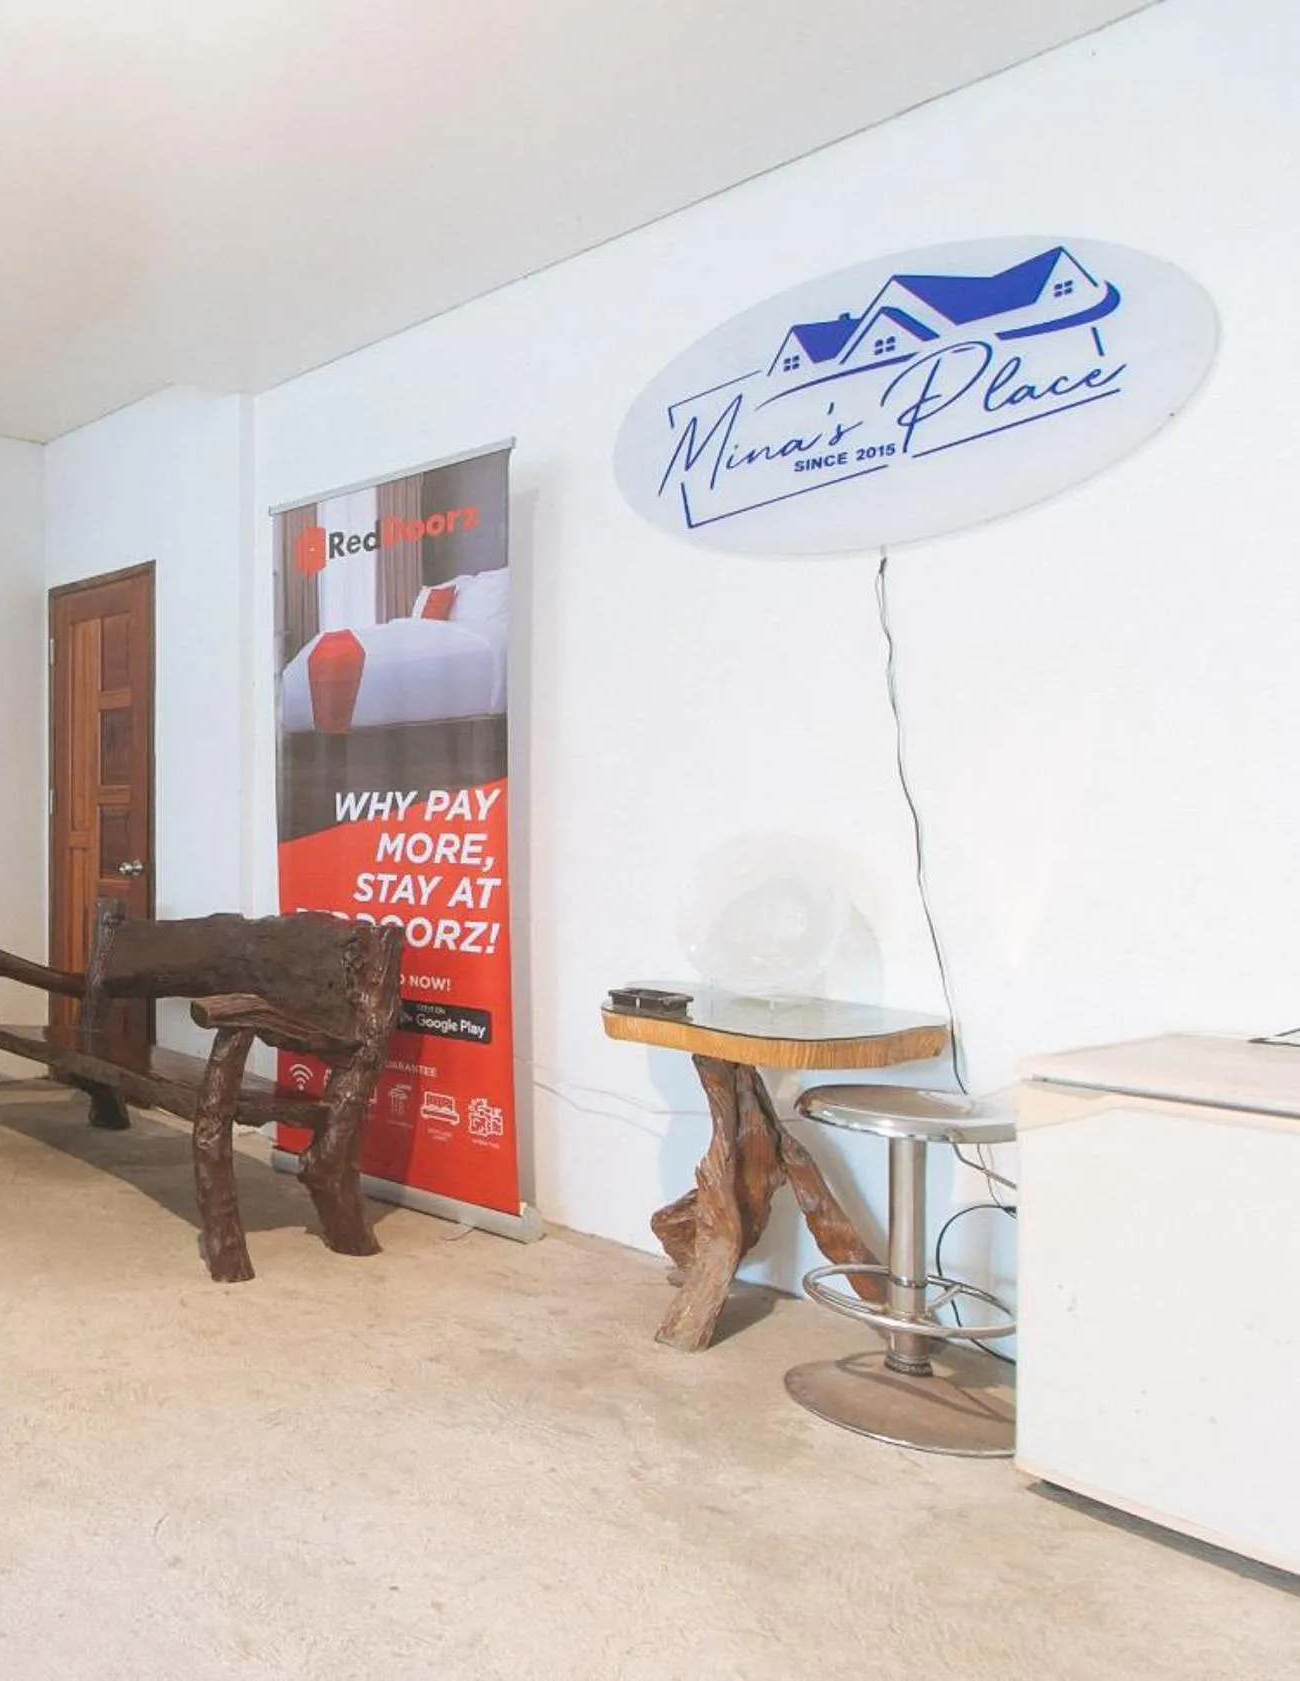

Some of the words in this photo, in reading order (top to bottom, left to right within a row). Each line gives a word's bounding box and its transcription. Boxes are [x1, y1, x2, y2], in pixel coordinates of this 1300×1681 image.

[658, 392, 864, 496] Mina's
[879, 340, 1127, 453] Place
[794, 451, 848, 472] SINCE
[856, 443, 896, 461] 2015
[328, 506, 479, 560] RedDoorz
[334, 791, 418, 822] WHY
[424, 789, 501, 822] PAY
[375, 832, 495, 872] MORE,
[353, 872, 442, 906] STAY
[446, 876, 501, 909] AT
[409, 975, 452, 992] NOW!
[416, 1013, 458, 1034] Google
[460, 1019, 486, 1039] Play
